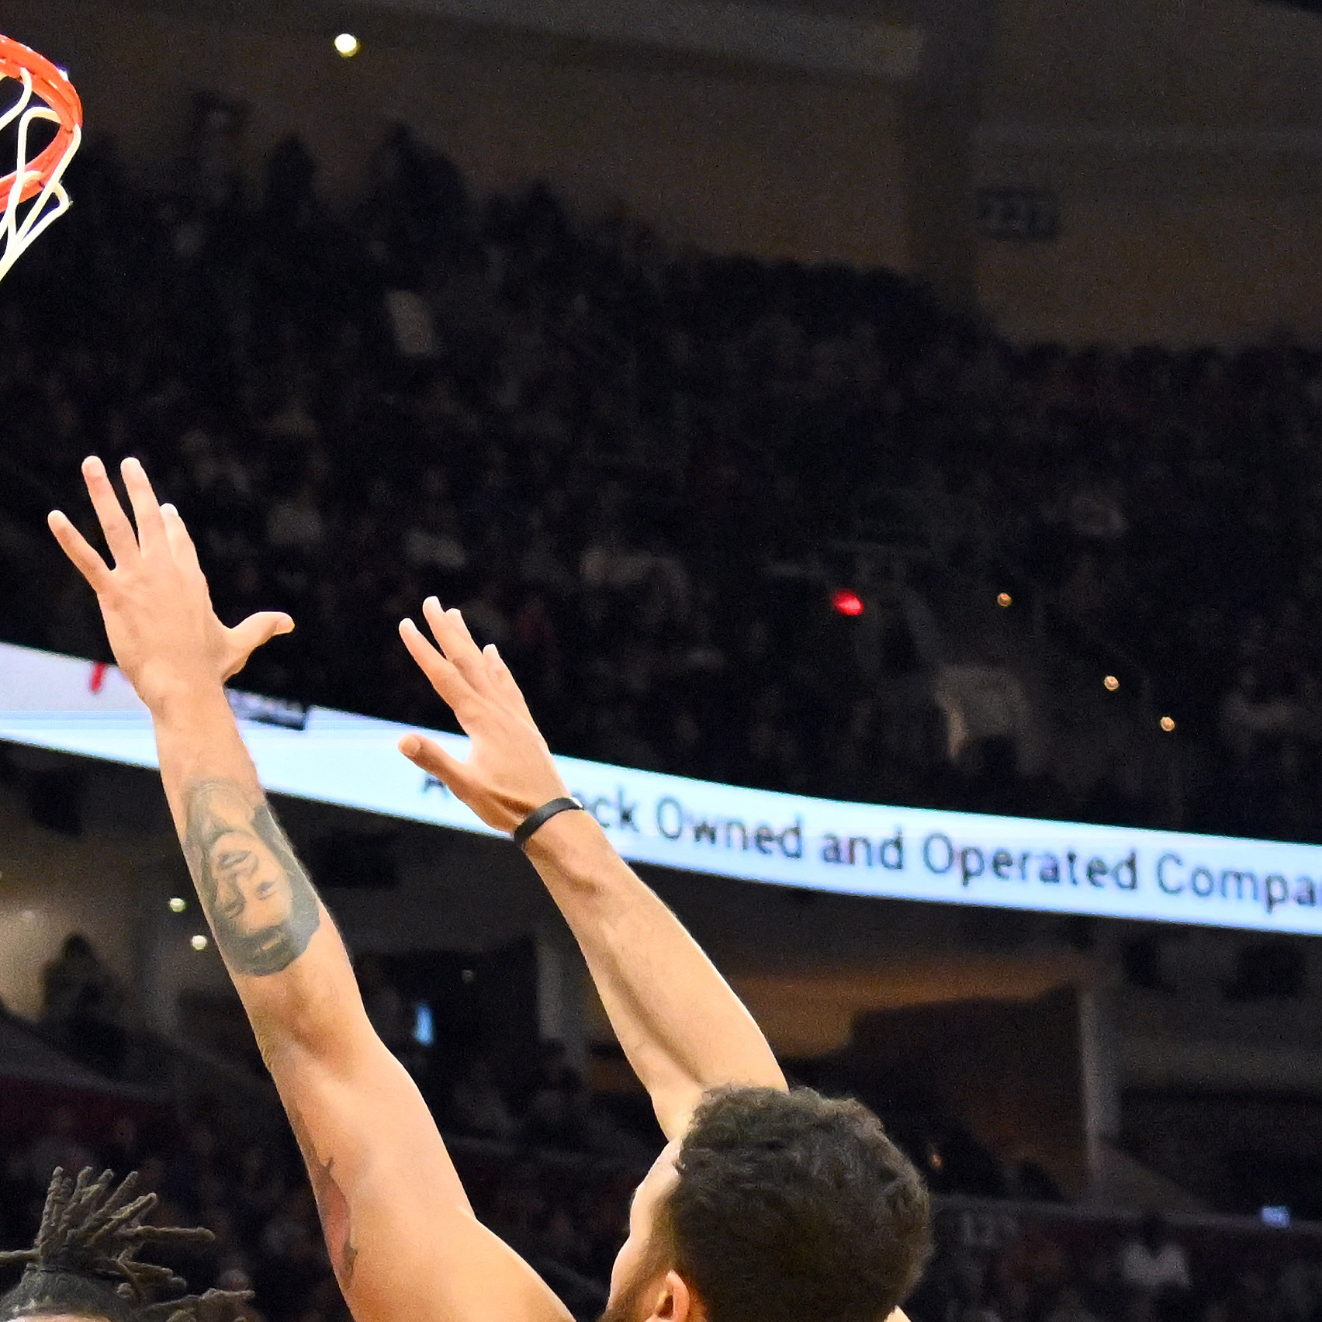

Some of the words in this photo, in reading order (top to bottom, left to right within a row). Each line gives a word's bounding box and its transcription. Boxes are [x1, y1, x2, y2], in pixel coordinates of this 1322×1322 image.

[655, 796, 804, 860] Owned
[818, 825, 904, 872] and
[923, 831, 1138, 891] Operated
[1156, 852, 1322, 914] Compa
